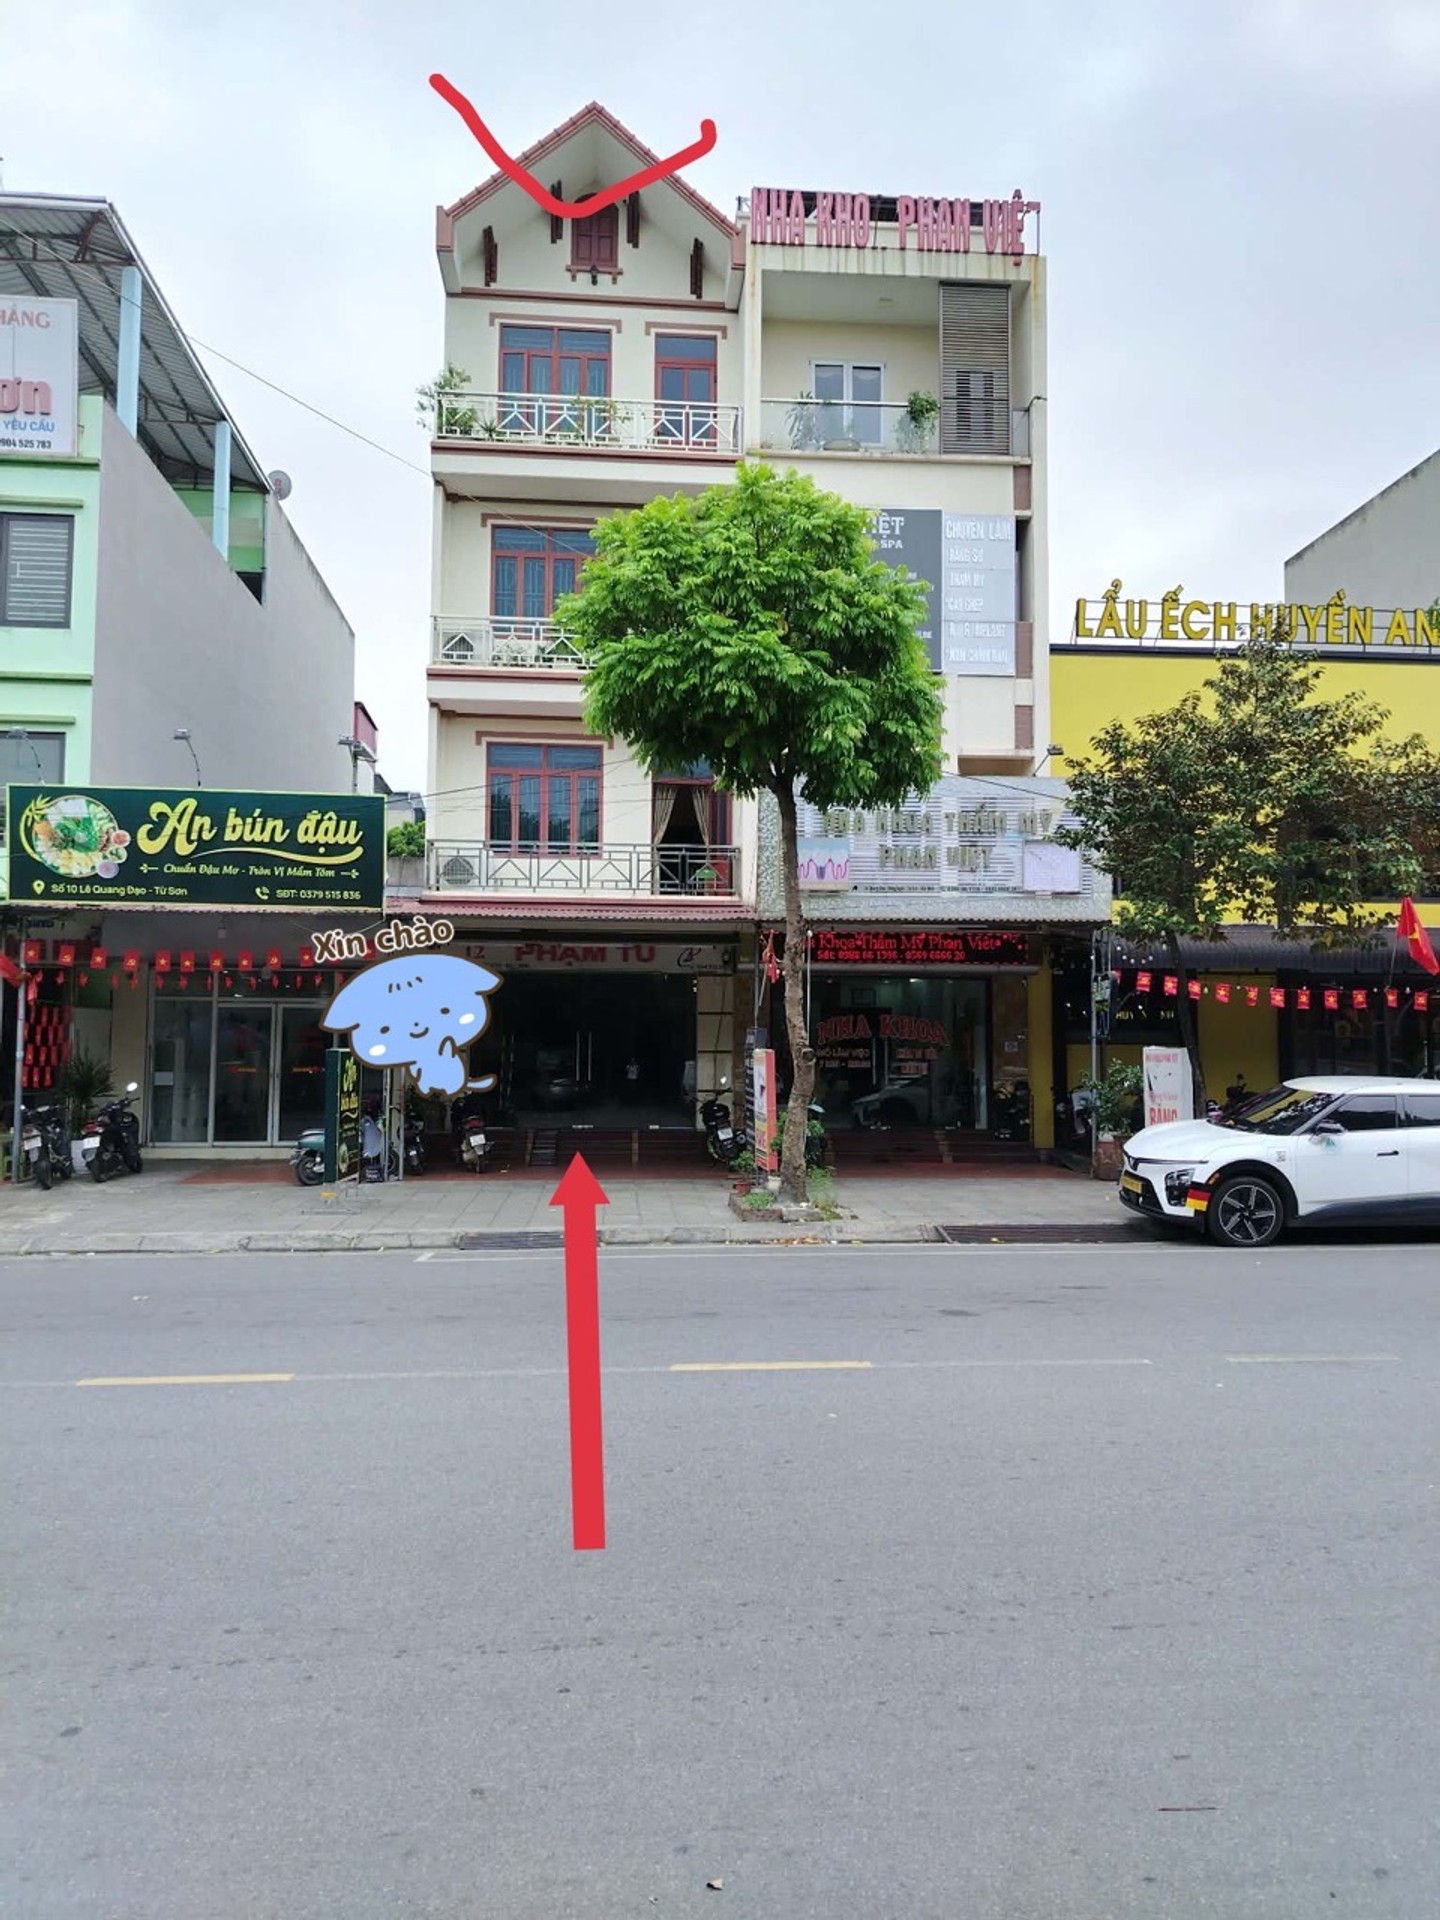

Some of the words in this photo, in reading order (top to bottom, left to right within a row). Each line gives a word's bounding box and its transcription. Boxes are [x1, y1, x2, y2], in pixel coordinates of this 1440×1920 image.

[1076, 579, 1148, 638] LẨU
[1161, 583, 1237, 642] ẾCH
[137, 797, 218, 856] An
[224, 807, 290, 843] bún
[296, 810, 364, 854] đậu
[51, 882, 65, 894] Số
[67, 885, 77, 894] 10
[79, 884, 91, 894] Lê
[93, 886, 126, 897] Quang
[127, 886, 147, 897] Đạo
[169, 886, 188, 896] Sơn
[300, 889, 324, 899] 0379
[325, 890, 341, 899] 515
[343, 891, 361, 900] 836
